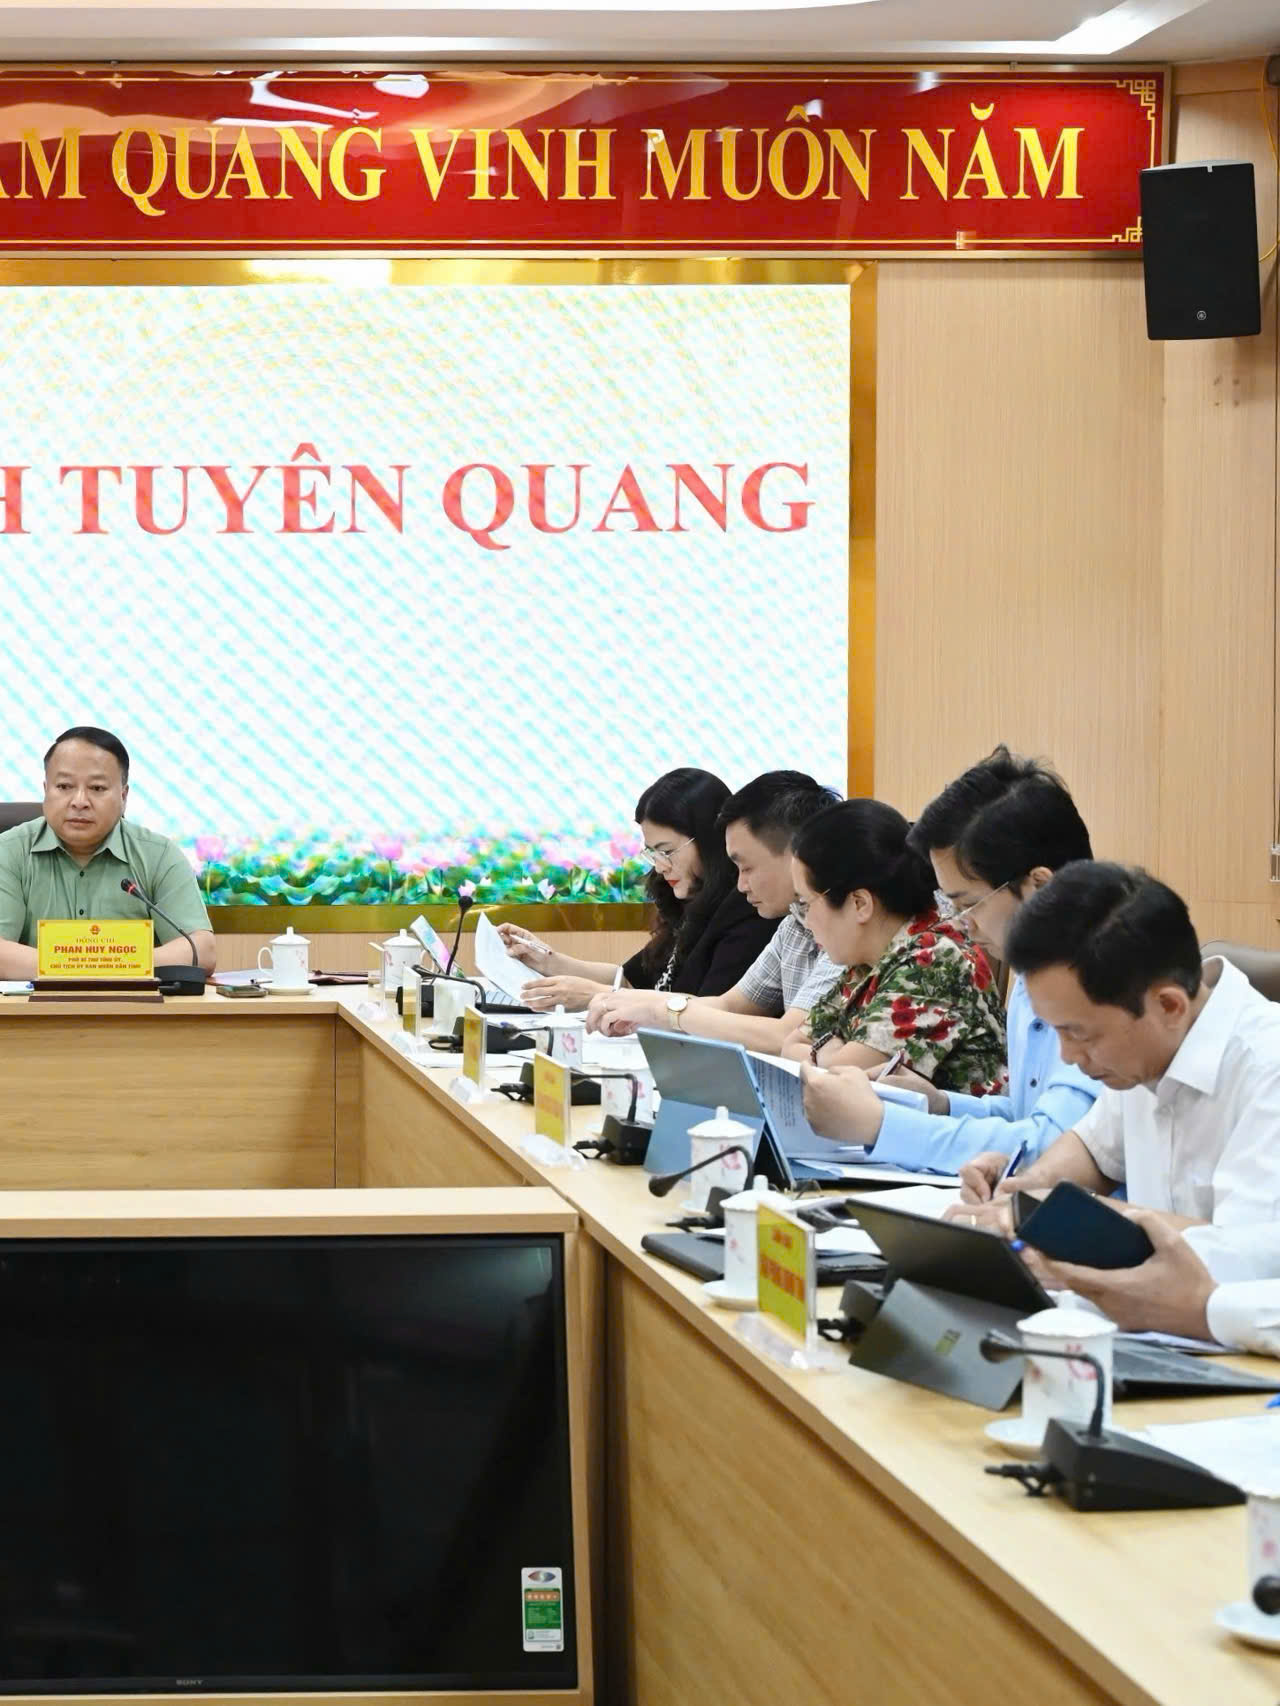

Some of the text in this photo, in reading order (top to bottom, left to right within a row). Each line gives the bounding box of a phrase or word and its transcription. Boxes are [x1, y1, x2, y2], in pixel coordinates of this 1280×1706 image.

[112, 126, 387, 217] QUANG
[409, 127, 617, 200] VINH
[640, 104, 877, 201] MUÔN
[900, 102, 1086, 200] NĂM
[59, 442, 411, 535] TUYÊN
[441, 462, 816, 551] QUANG
[54, 945, 83, 954] PHAN
[86, 945, 106, 954] HUY
